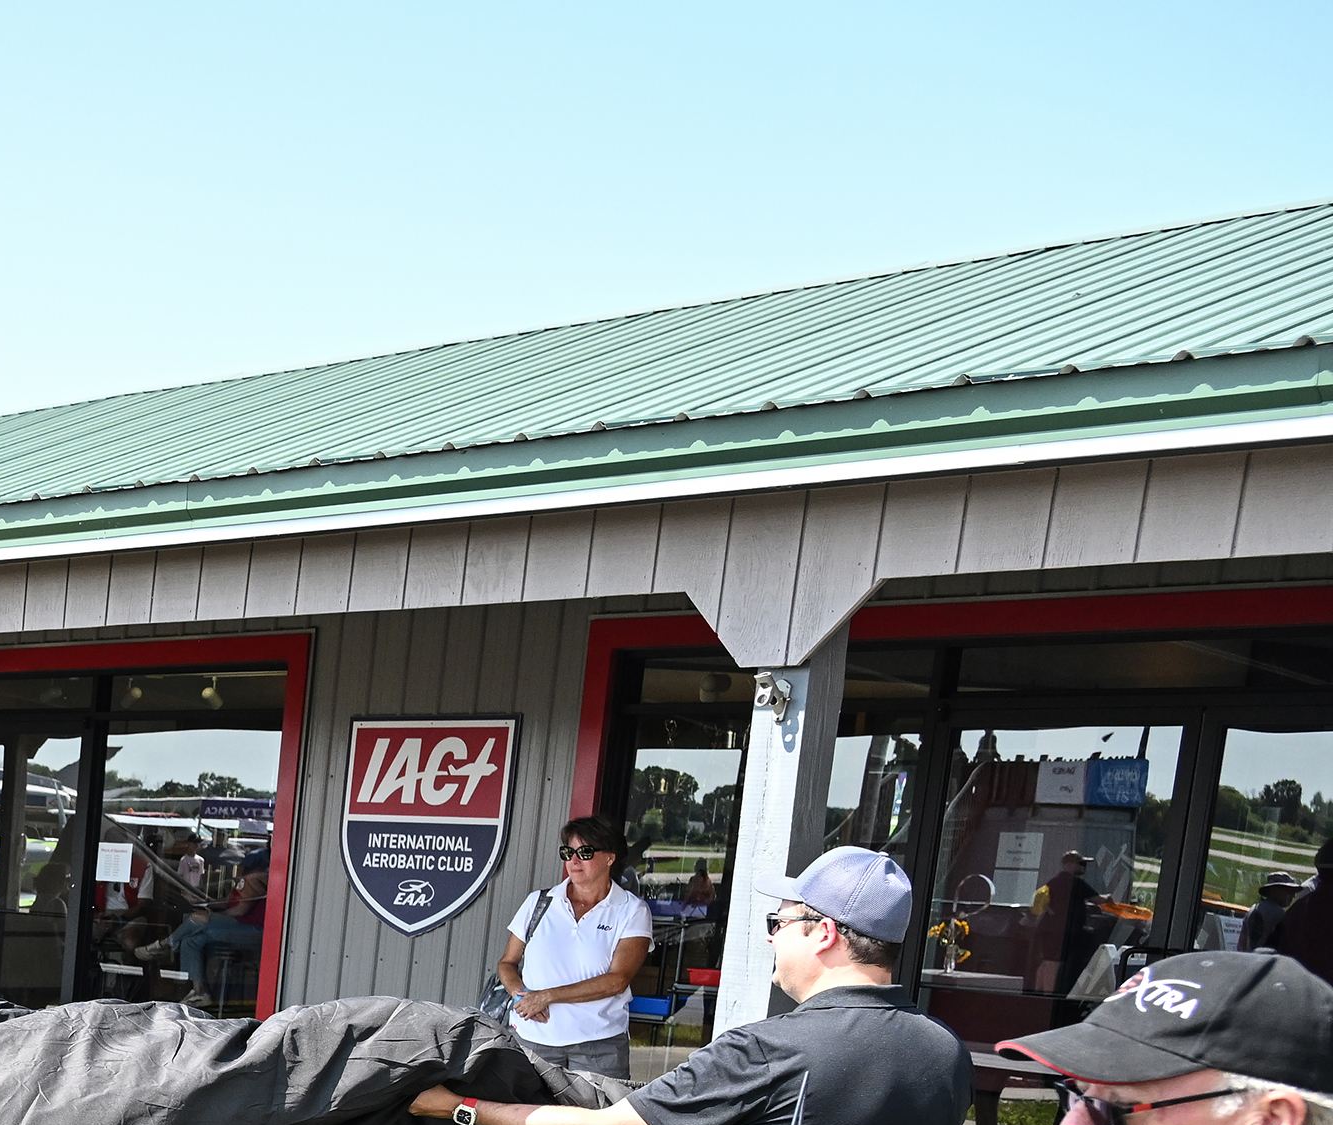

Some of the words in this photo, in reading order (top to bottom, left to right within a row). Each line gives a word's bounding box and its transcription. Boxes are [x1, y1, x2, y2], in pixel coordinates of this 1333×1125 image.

[368, 833, 472, 852] INTERNATIONAL
[363, 853, 434, 871] AEROBATIC
[437, 856, 474, 872] CLUB
[393, 893, 426, 906] EAA
